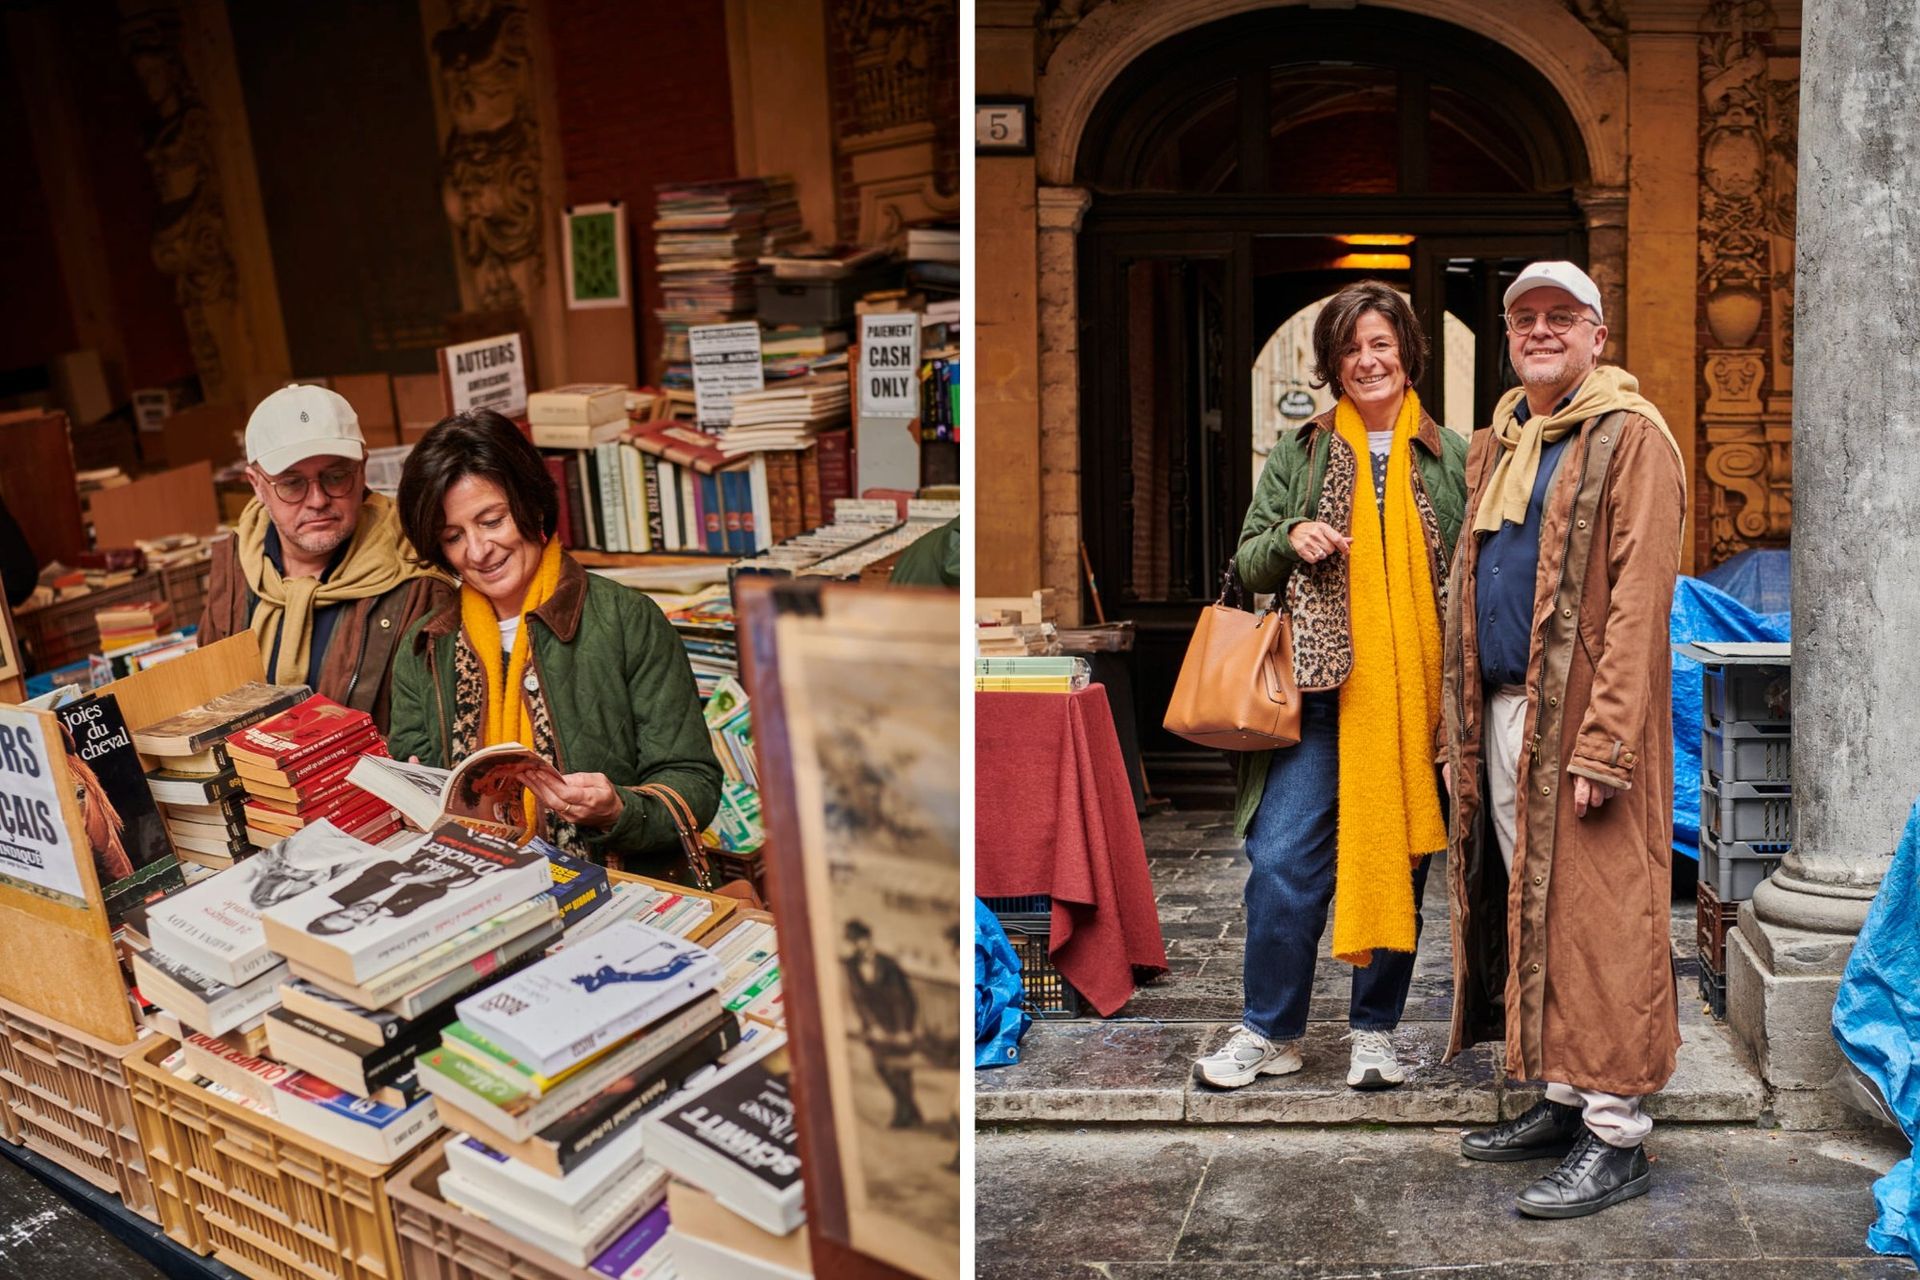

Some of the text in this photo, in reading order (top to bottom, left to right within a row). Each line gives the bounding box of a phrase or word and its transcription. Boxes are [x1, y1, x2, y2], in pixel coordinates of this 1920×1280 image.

[990, 113, 1008, 141] 5
[867, 324, 912, 338] PAIEMENT
[456, 342, 516, 375] AUTEURS
[869, 345, 911, 367] CASH
[871, 377, 909, 398] ONLY
[645, 469, 660, 513] BIBLE
[63, 703, 103, 733] joies
[87, 720, 110, 741] du
[0, 724, 40, 778] RS
[81, 726, 131, 761] cheval
[0, 790, 58, 845] ÇAIS
[415, 856, 464, 878] Michel
[421, 841, 504, 876] Drucker
[166, 914, 199, 941] VLADY
[188, 1032, 288, 1080] OLIVIER TODD
